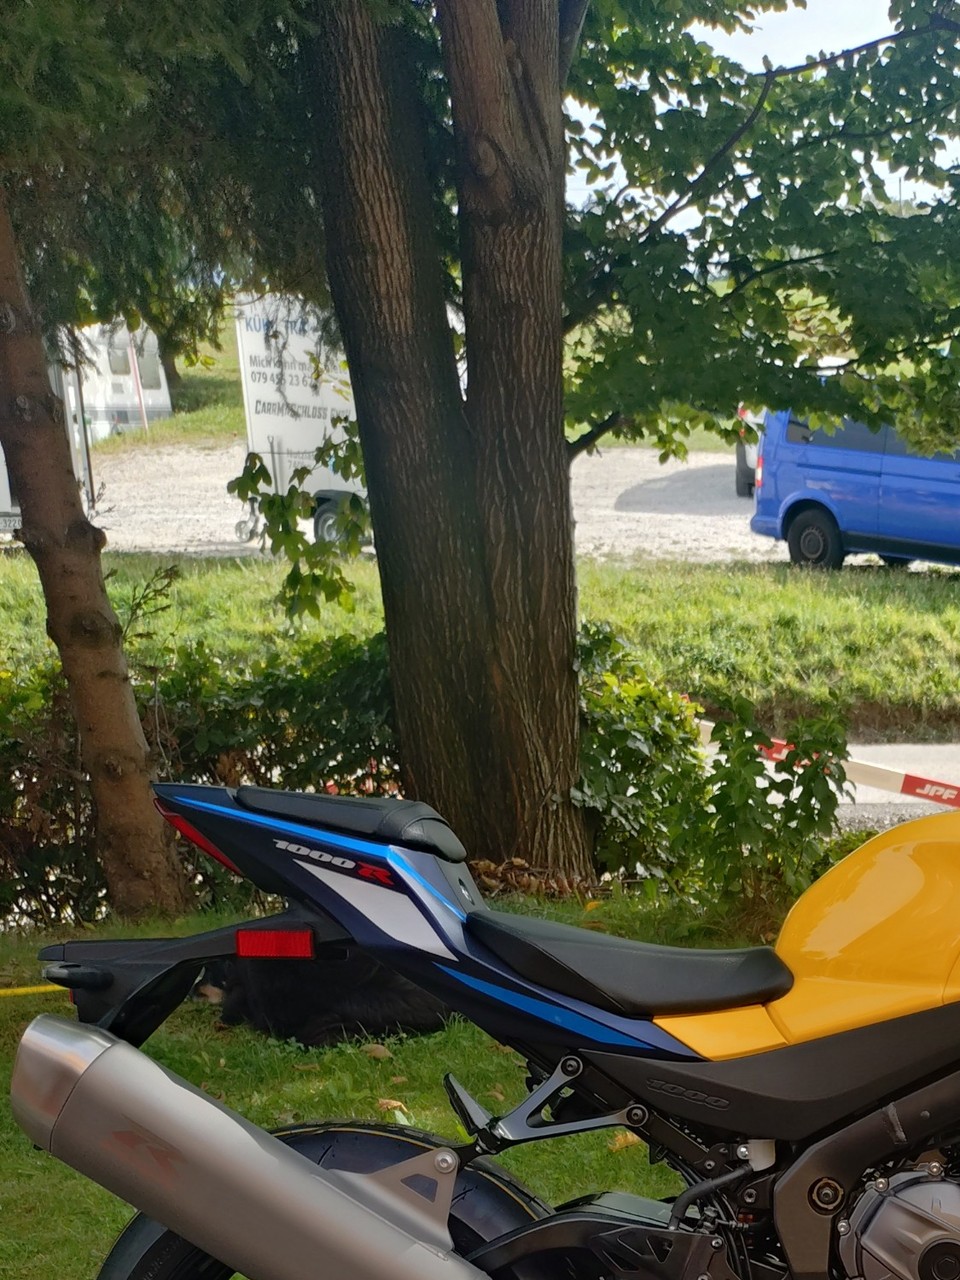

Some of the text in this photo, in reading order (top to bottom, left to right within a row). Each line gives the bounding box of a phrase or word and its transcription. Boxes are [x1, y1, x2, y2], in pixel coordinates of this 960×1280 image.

[251, 371, 267, 384] 079
[289, 374, 300, 387] 23
[915, 783, 958, 800] JPF
[644, 1076, 731, 1111] 1000
